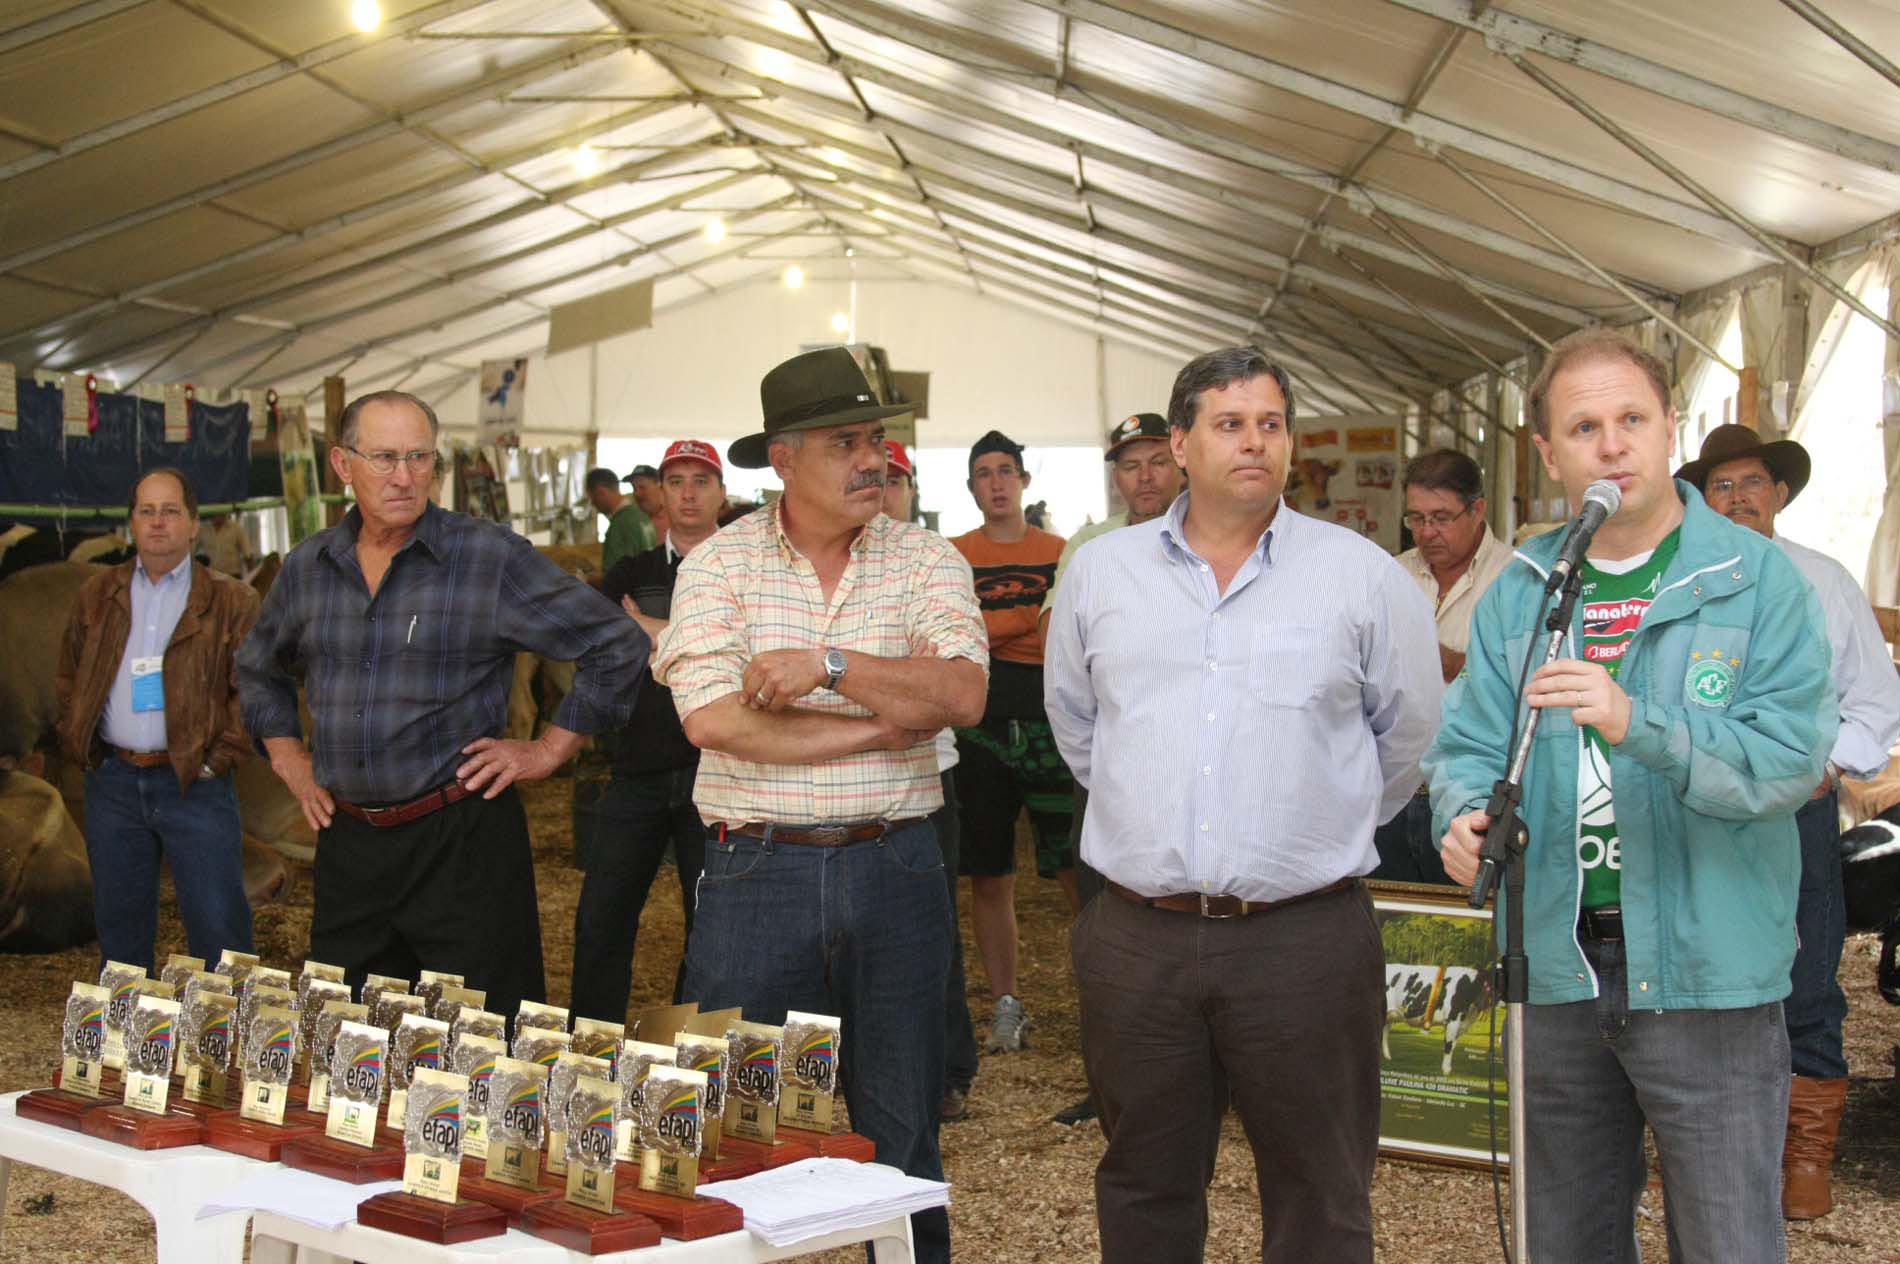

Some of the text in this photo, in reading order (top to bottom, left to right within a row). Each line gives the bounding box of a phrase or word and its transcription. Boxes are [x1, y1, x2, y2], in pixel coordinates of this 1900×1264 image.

[75, 1026, 101, 1056] efapi
[141, 1040, 169, 1068] efapi
[199, 1034, 227, 1065] efapi
[259, 1048, 289, 1074] efapi
[797, 1054, 832, 1085] efapi
[347, 1066, 379, 1097] efapi
[739, 1063, 775, 1095] efapi
[423, 1119, 459, 1152] efapi
[505, 1106, 539, 1139] efapi
[659, 1114, 697, 1146] efapi
[581, 1127, 613, 1162] efapi
